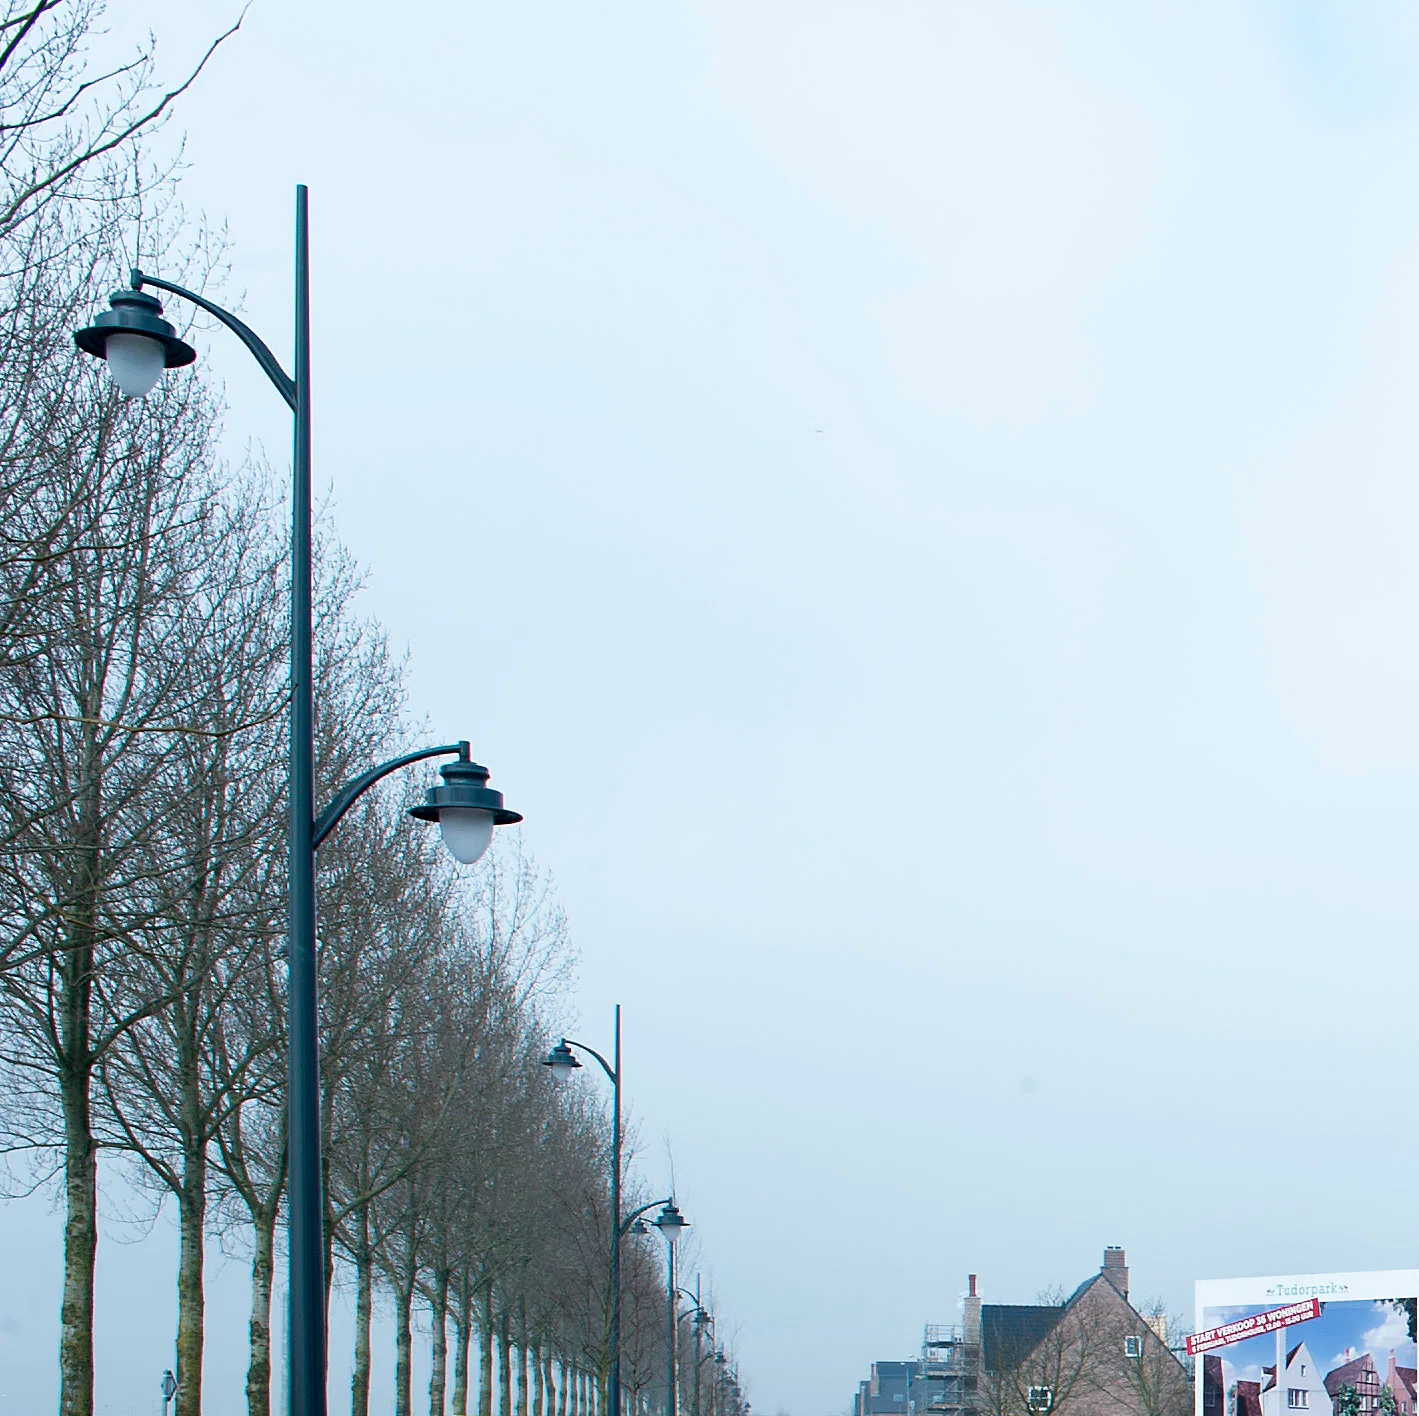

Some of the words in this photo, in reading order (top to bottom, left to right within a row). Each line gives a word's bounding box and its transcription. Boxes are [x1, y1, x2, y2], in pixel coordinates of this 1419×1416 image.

[1276, 1281, 1337, 1298] Tudorpark
[1190, 1329, 1216, 1345] START
[1216, 1317, 1256, 1338] VERKOOP
[1267, 1300, 1313, 1321] WONINGEN
